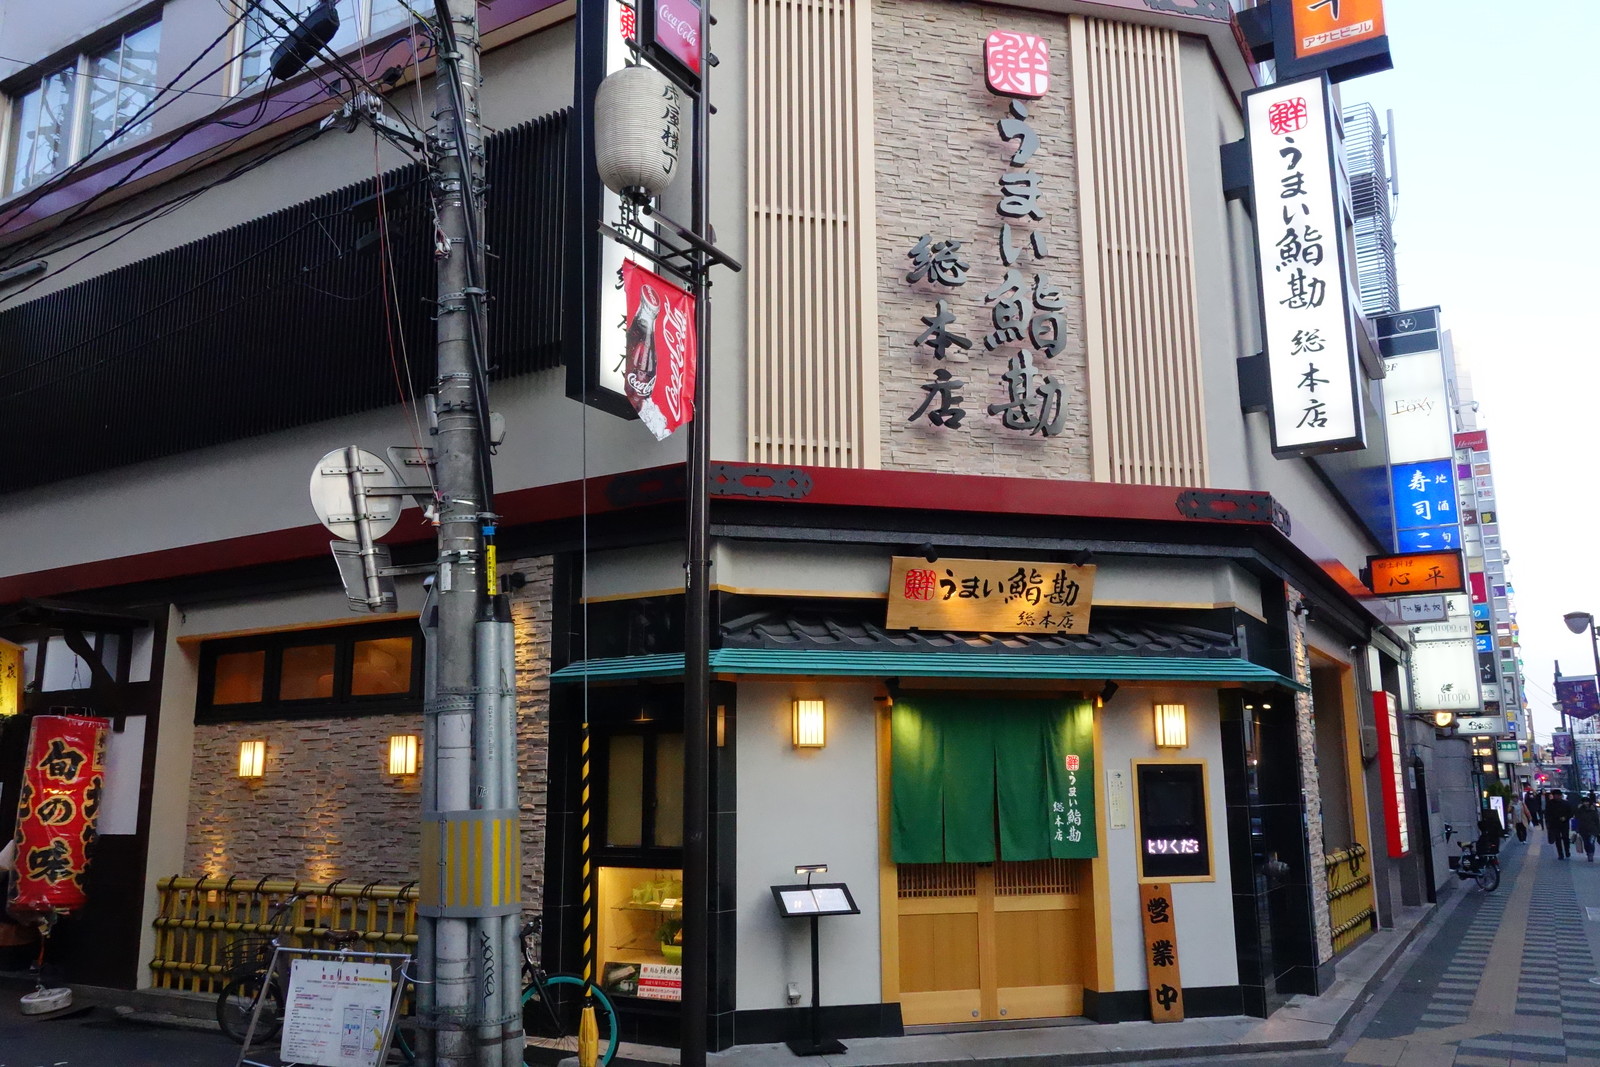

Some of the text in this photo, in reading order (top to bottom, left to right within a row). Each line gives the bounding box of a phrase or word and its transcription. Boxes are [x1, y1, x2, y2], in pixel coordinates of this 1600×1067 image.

[1304, 22, 1372, 47] アサヒビール
[984, 101, 1067, 437] うまい鮨勘
[1275, 137, 1330, 430] うまい鮨勘 総本店
[906, 234, 972, 430] 総本店
[1408, 469, 1432, 520] 寿司
[1435, 473, 1450, 511] 地酒
[939, 568, 1080, 606] うまい鮨勘
[1388, 565, 1445, 587] 心平
[1017, 610, 1075, 630] 総本店
[1437, 692, 1471, 704] piropo
[28, 741, 85, 883] 旬の味
[1053, 801, 1064, 842] 総本店
[1067, 772, 1081, 842] うまい鮨勘
[1146, 897, 1178, 1011] 営業中
